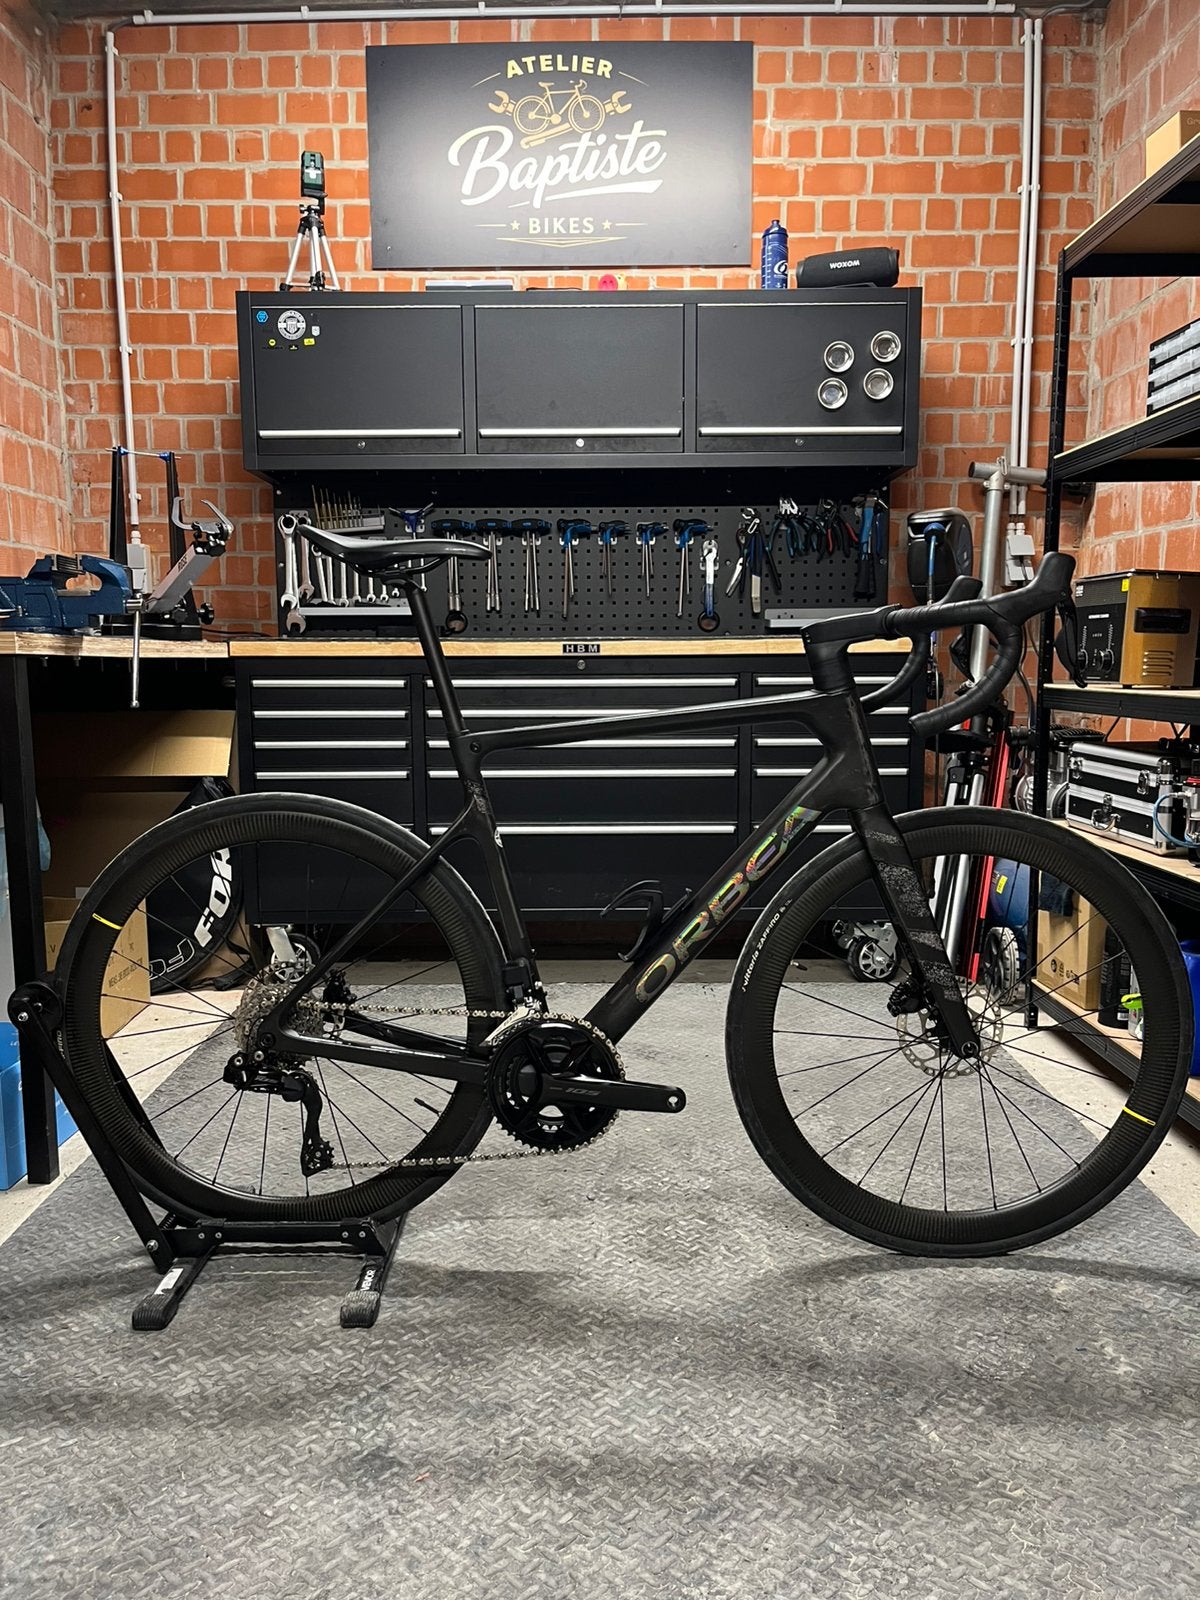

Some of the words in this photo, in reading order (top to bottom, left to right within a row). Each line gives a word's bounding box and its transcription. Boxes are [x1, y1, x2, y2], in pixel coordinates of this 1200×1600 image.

[506, 54, 614, 79] ATELIER
[448, 119, 668, 208] Baptiste
[528, 217, 595, 234] BIKES
[829, 259, 860, 270] WOXOM
[566, 644, 598, 653] HBM
